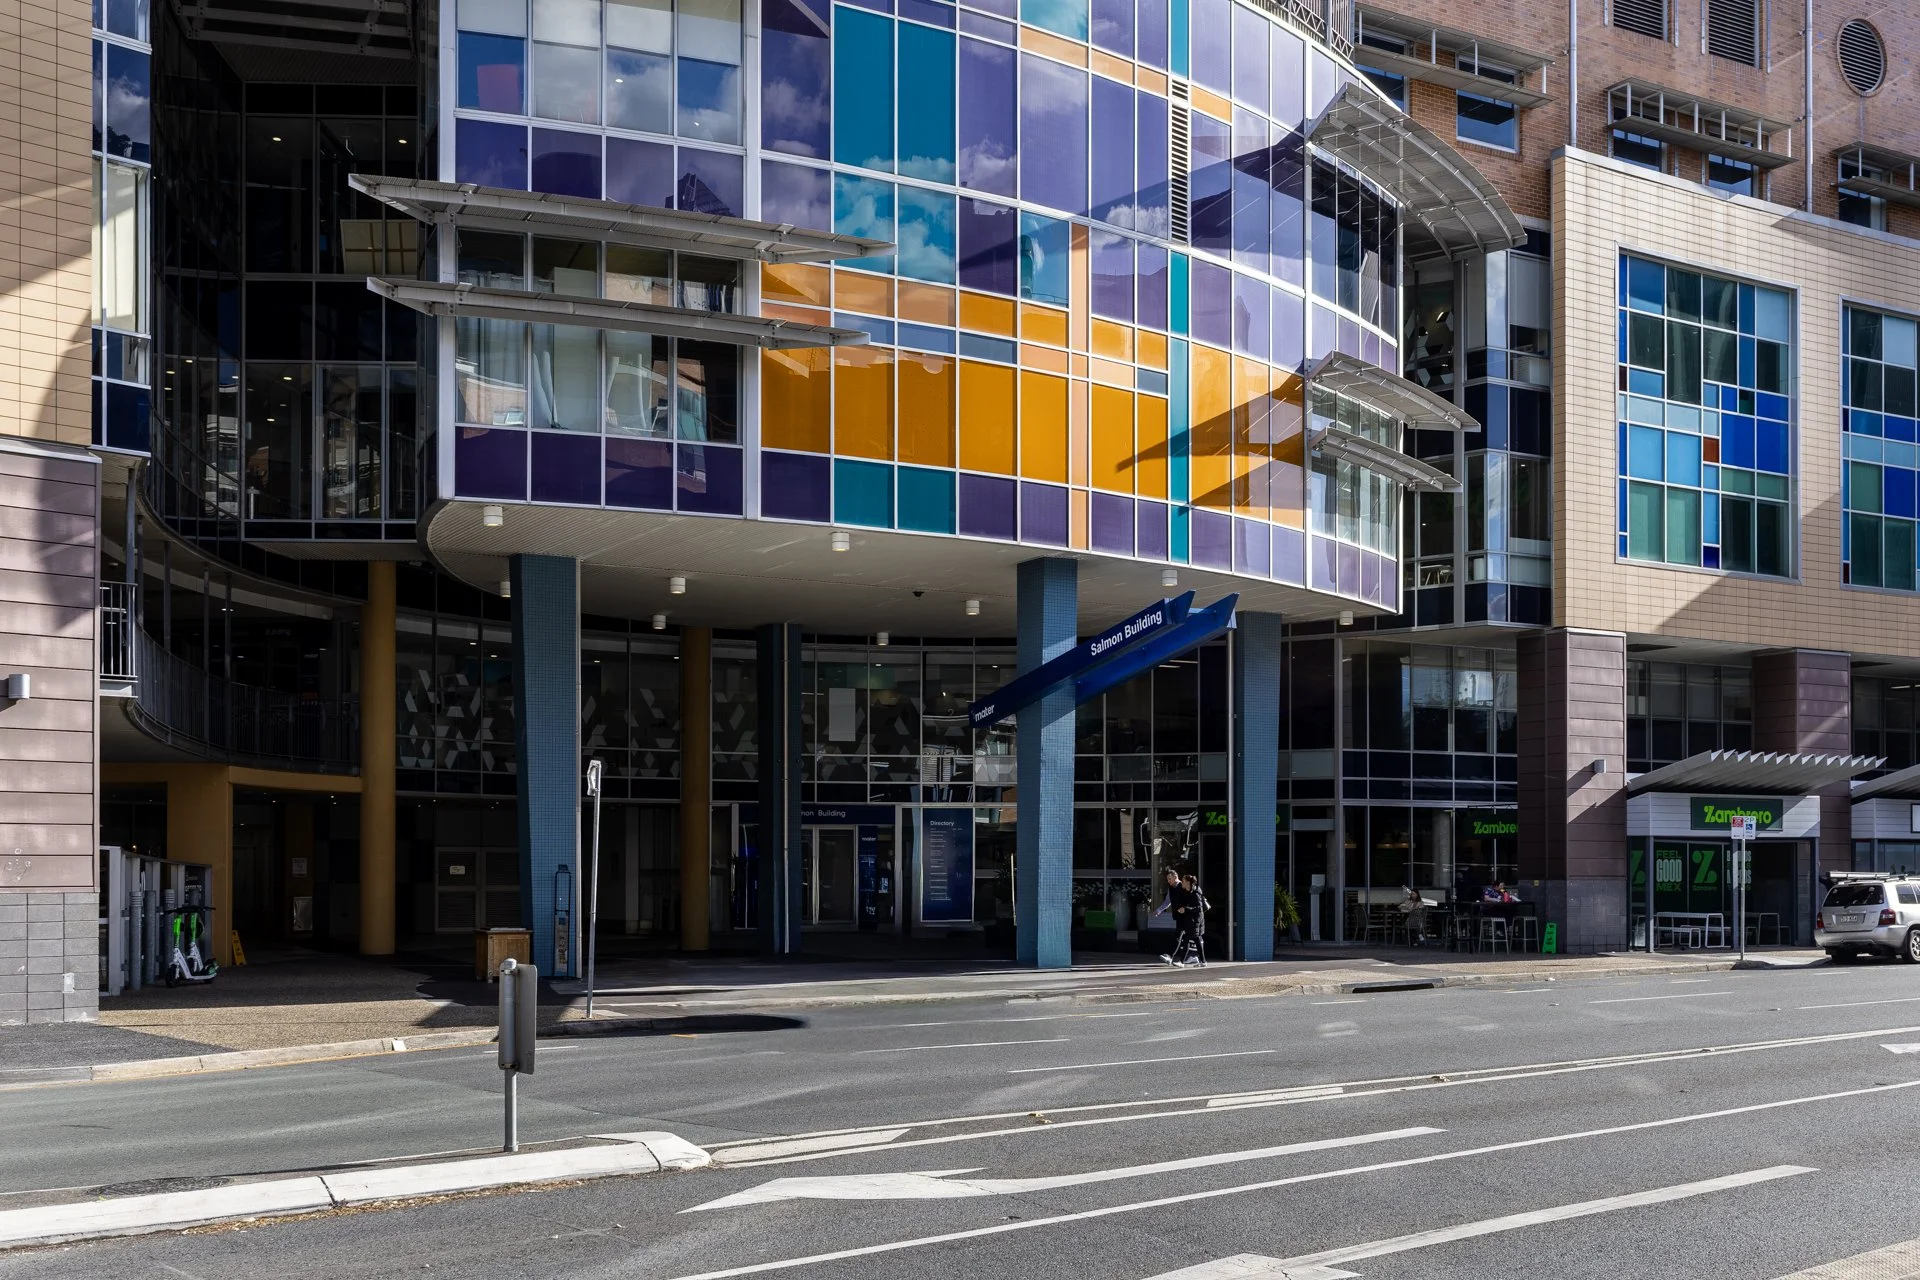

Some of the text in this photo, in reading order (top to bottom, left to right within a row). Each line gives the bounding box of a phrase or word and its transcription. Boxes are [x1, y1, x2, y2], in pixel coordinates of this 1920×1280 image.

[1090, 610, 1163, 656] Salmon Building
[975, 704, 995, 722] mater
[818, 809, 846, 819] Building
[1473, 820, 1519, 834] Zambre
[1656, 849, 1682, 859] FEEL
[1656, 858, 1682, 883] GOOD
[1656, 882, 1682, 892] MEX
